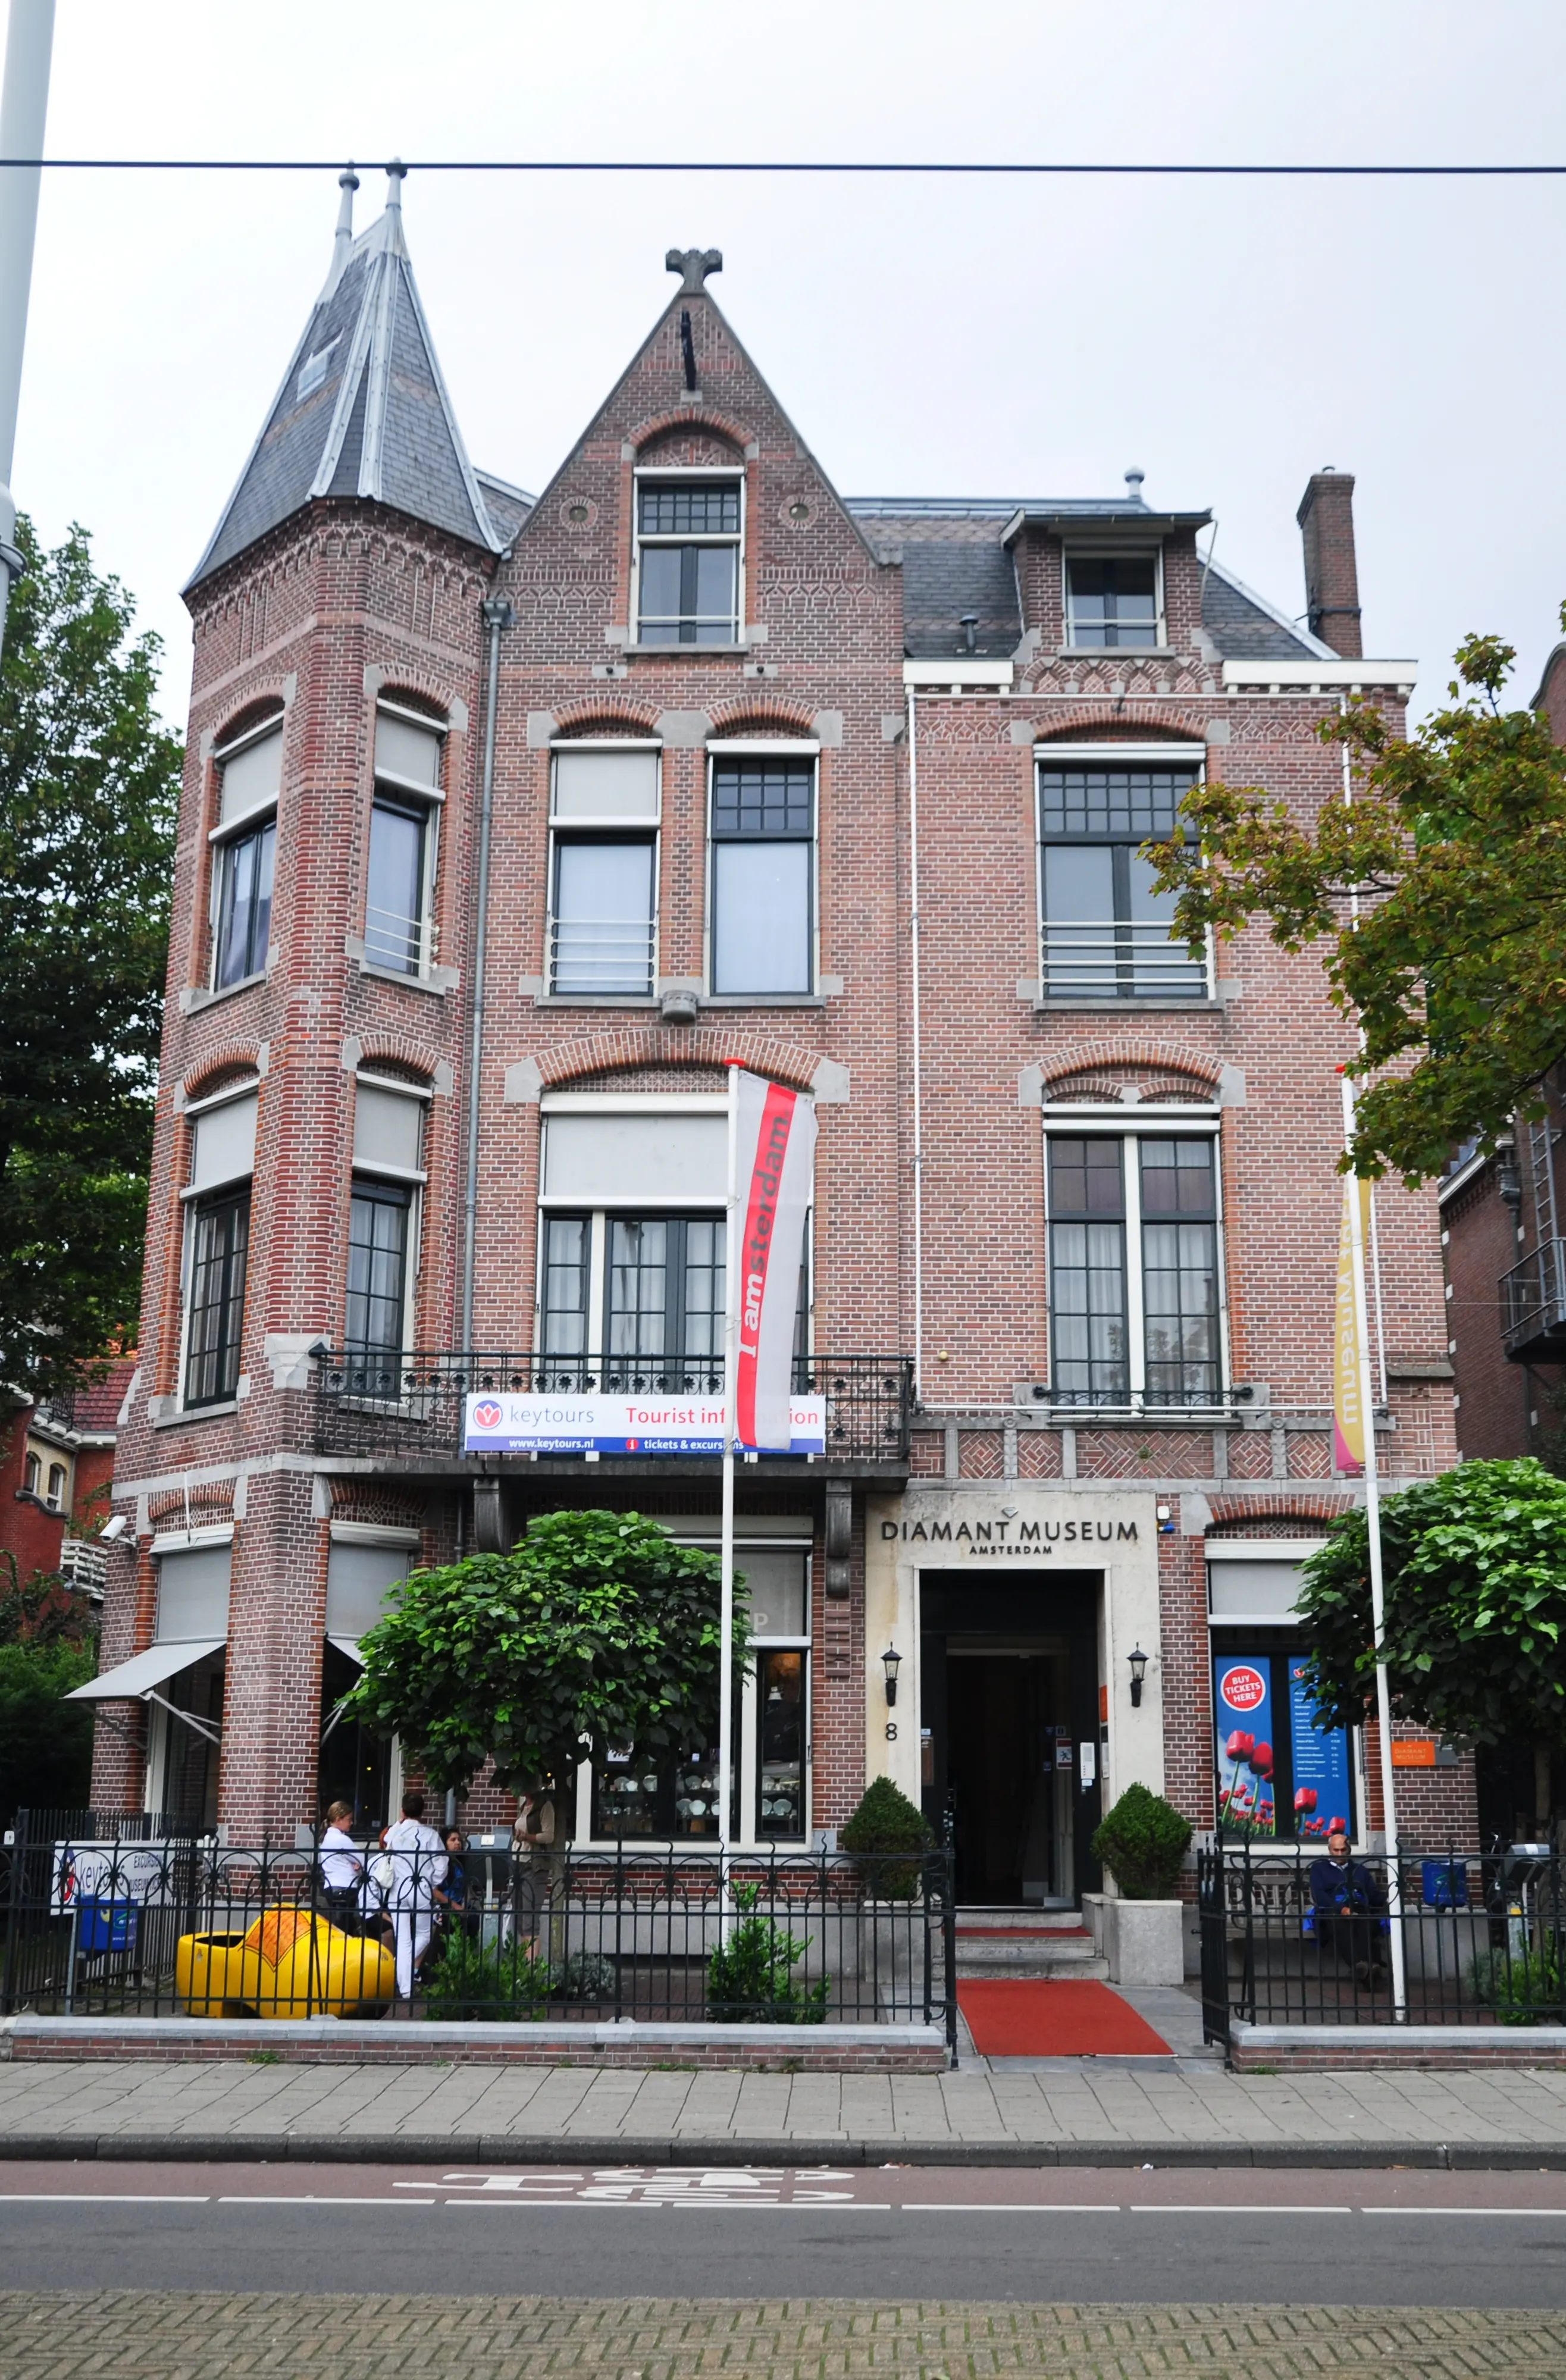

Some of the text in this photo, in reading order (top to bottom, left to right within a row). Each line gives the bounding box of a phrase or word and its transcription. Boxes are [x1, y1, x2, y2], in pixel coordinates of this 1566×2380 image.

[510, 1405, 594, 1427] keytours
[626, 1407, 818, 1424] Tourist infion
[509, 1438, 594, 1450] www.keytours.nl
[644, 1439, 678, 1449] tickets
[679, 1440, 688, 1449] &
[691, 1442, 744, 1450] excursns
[881, 1521, 1138, 1540] DIAMANT MUSEUM
[969, 1546, 1052, 1555] AMSTERDAM
[1232, 1674, 1250, 1685] BUY
[1225, 1681, 1261, 1695] TICKETS
[1233, 1692, 1257, 1703] HERE
[885, 1723, 897, 1741] 8
[80, 1856, 125, 1894] keytos
